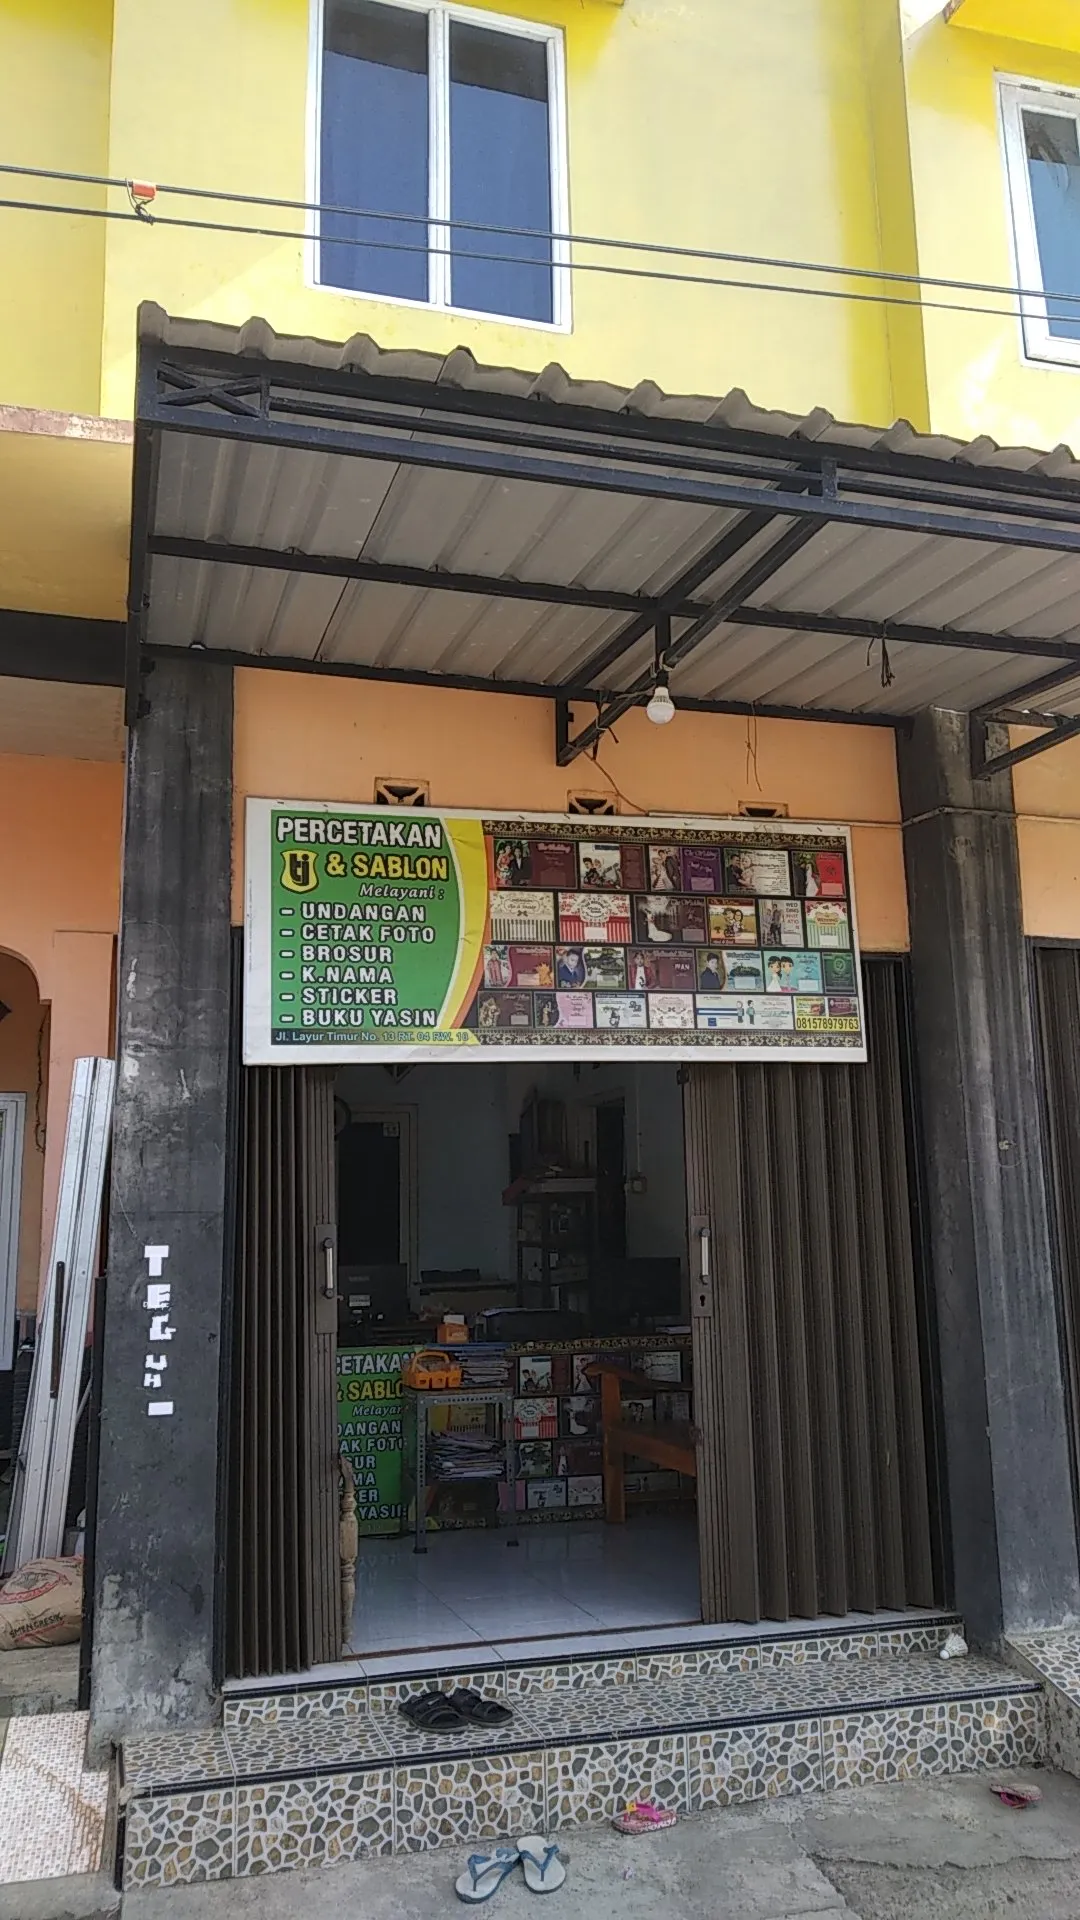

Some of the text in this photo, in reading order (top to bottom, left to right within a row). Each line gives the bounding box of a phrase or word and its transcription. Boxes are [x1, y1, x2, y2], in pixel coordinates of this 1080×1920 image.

[277, 817, 442, 848] PERCETAKAN
[326, 853, 448, 880] & SABLON
[359, 884, 435, 901] Melayani
[302, 903, 426, 922] UNDANGAN
[302, 924, 373, 942] CETAK
[380, 926, 436, 943] FOTO
[302, 945, 393, 963] BROSUR
[302, 966, 393, 983] K.NAMA
[302, 987, 398, 1005] STICKER
[302, 1008, 364, 1027] BUKU
[372, 1009, 437, 1027] YASIN
[796, 1017, 859, 1030] 081578979763
[292, 1032, 325, 1044] Layur
[326, 1032, 360, 1042] Timur
[361, 1032, 379, 1042] No.
